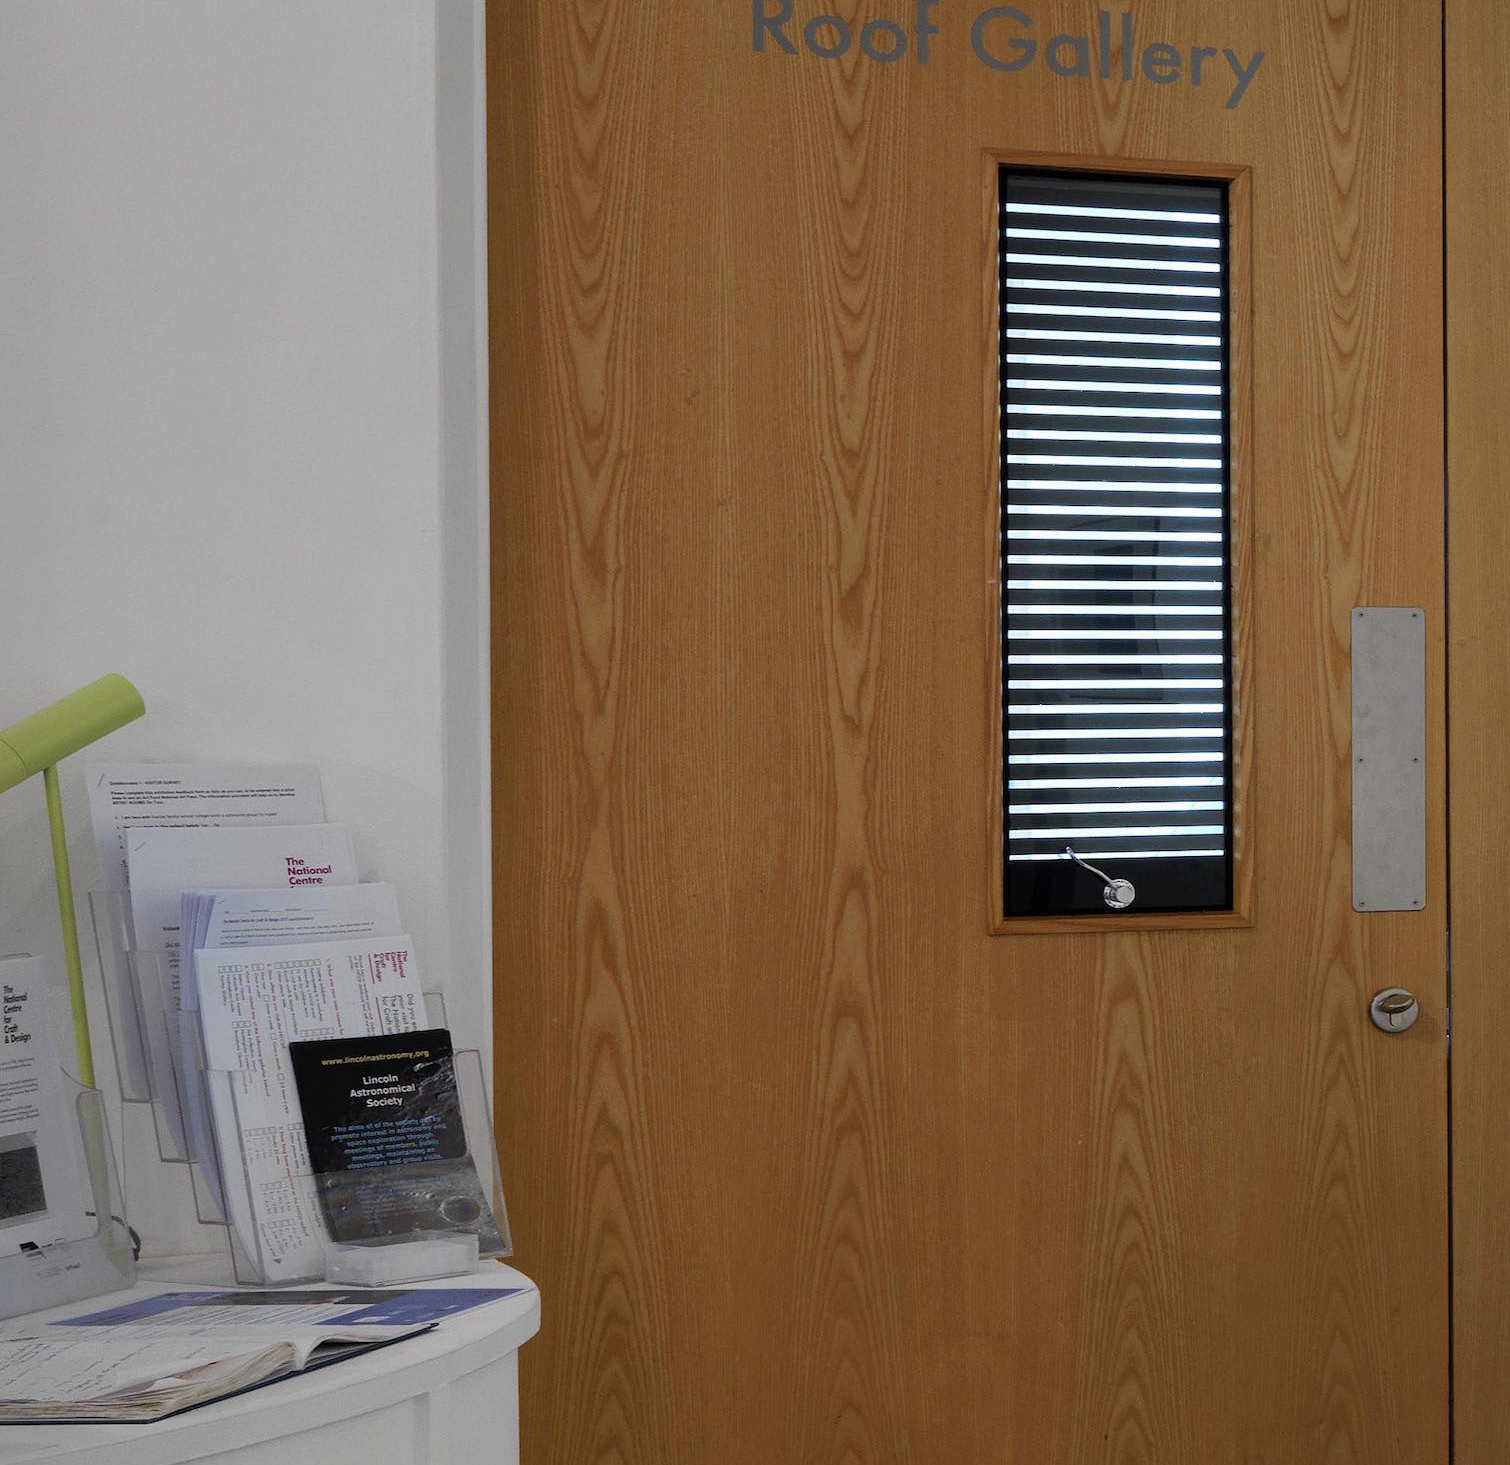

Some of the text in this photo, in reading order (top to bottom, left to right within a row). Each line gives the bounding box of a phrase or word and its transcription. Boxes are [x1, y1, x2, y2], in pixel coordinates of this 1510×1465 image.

[971, 7, 1266, 109] Gallery
[285, 857, 305, 866] The
[286, 865, 333, 877] National
[288, 876, 324, 886] Centre
[362, 1074, 400, 1085] Lincoln
[349, 1083, 417, 1098] Astronomical
[365, 1098, 404, 1109] Society
